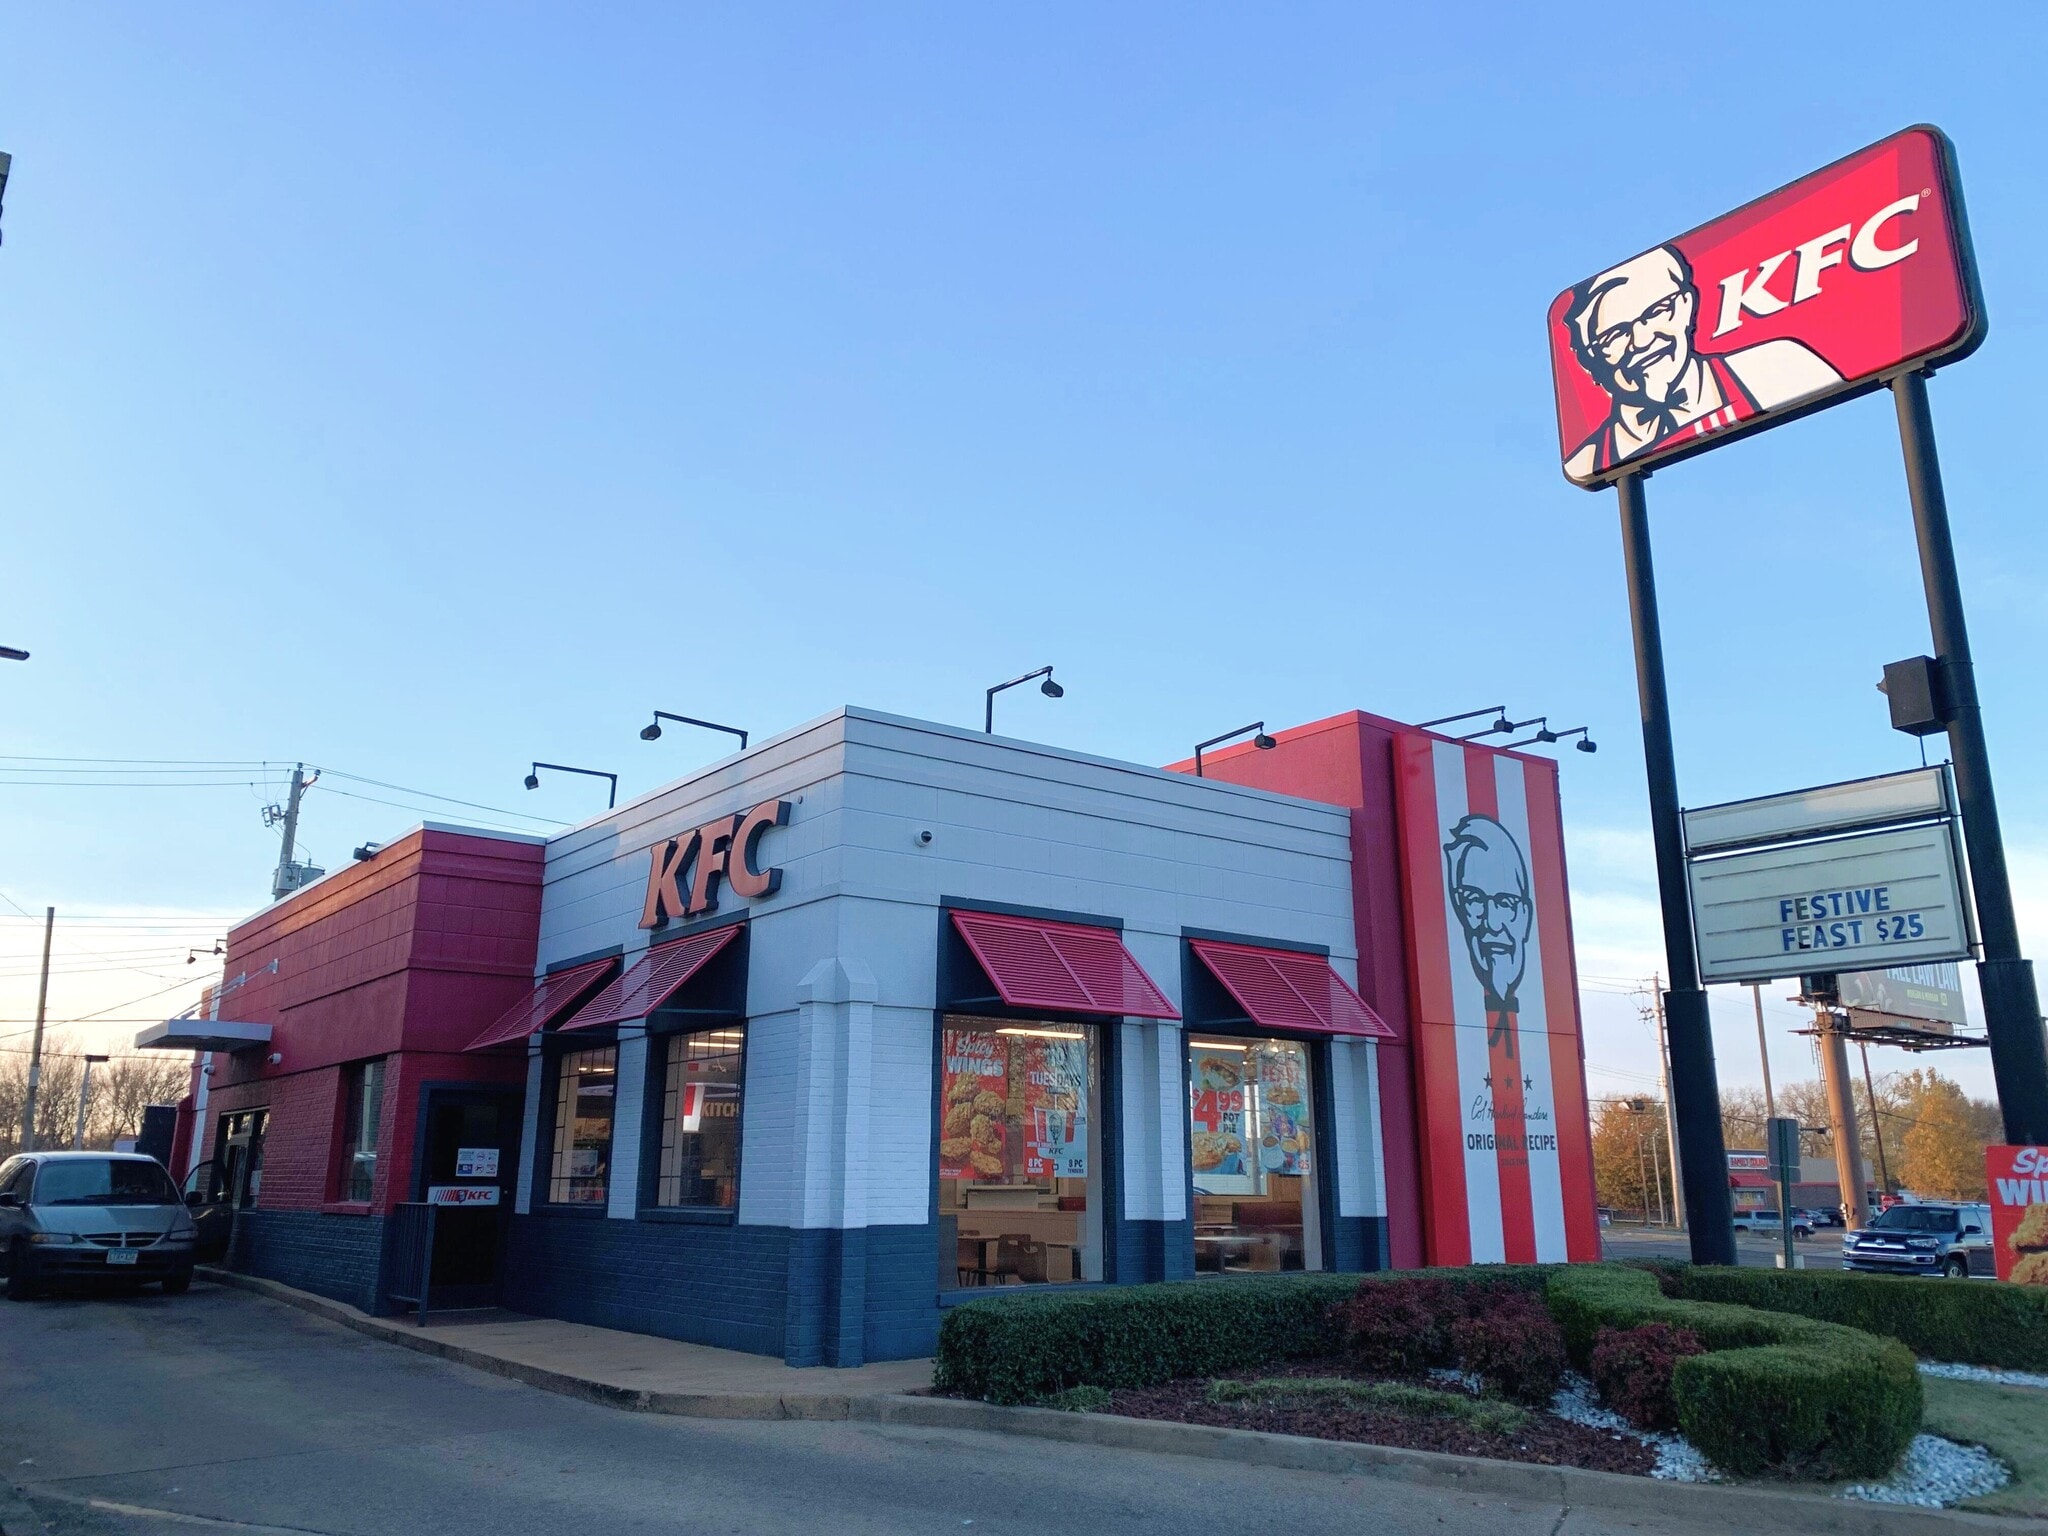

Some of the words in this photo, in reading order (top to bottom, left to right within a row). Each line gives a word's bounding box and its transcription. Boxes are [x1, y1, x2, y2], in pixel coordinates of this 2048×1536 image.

[1712, 193, 1920, 338] KFC
[638, 800, 791, 929] KFC
[1780, 887, 1890, 922] FESTIVE
[1782, 920, 1863, 951] FEAST
[1876, 914, 1924, 941] $25
[1936, 962, 1959, 992] LAW
[956, 1036, 994, 1058] Spicy
[946, 1055, 1004, 1077] WINGS
[1223, 1112, 1240, 1122] POT
[1223, 1123, 1237, 1133] PIE
[1467, 1133, 1518, 1151] ORIGINAL
[1522, 1134, 1556, 1151] RECIPE
[1068, 1158, 1073, 1168] 8
[1074, 1159, 1083, 1168] PC
[468, 1190, 493, 1201] KFC
[1996, 1178, 2048, 1207] WI
